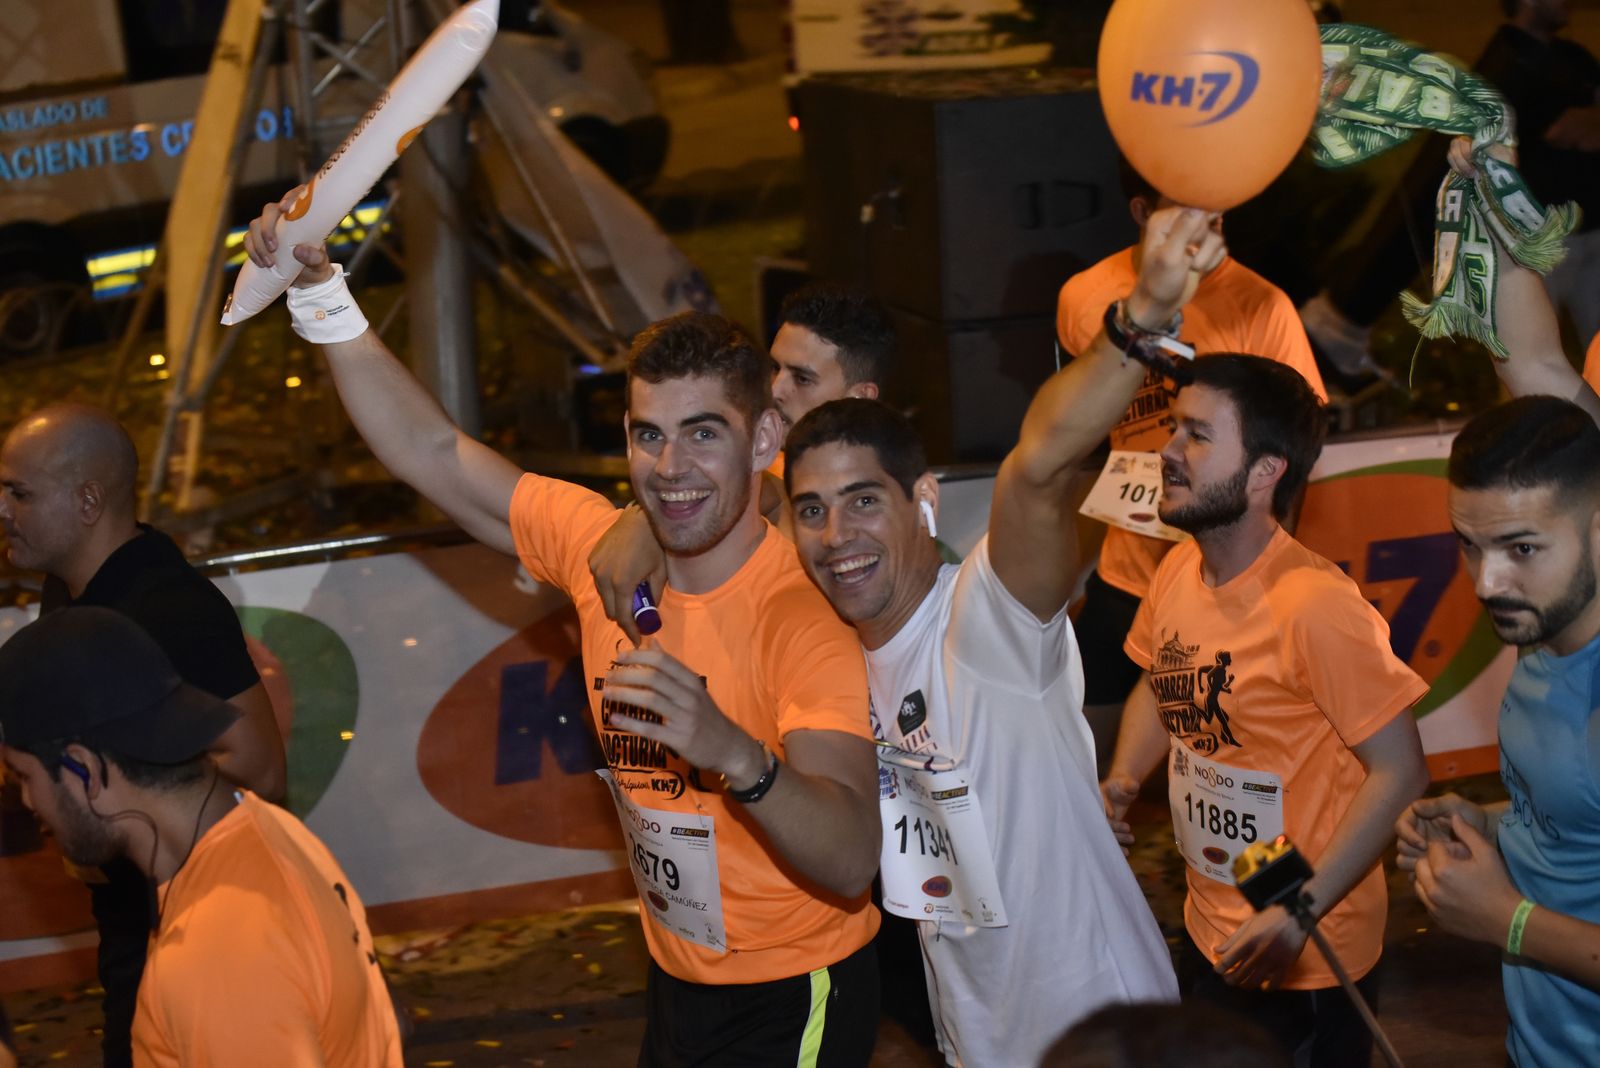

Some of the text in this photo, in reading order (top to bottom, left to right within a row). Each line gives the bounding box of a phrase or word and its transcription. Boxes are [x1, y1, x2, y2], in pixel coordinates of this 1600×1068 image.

[80, 96, 108, 120] DE
[1119, 481, 1158, 506] 101
[1184, 791, 1258, 844] 11885
[894, 814, 958, 866] 11341
